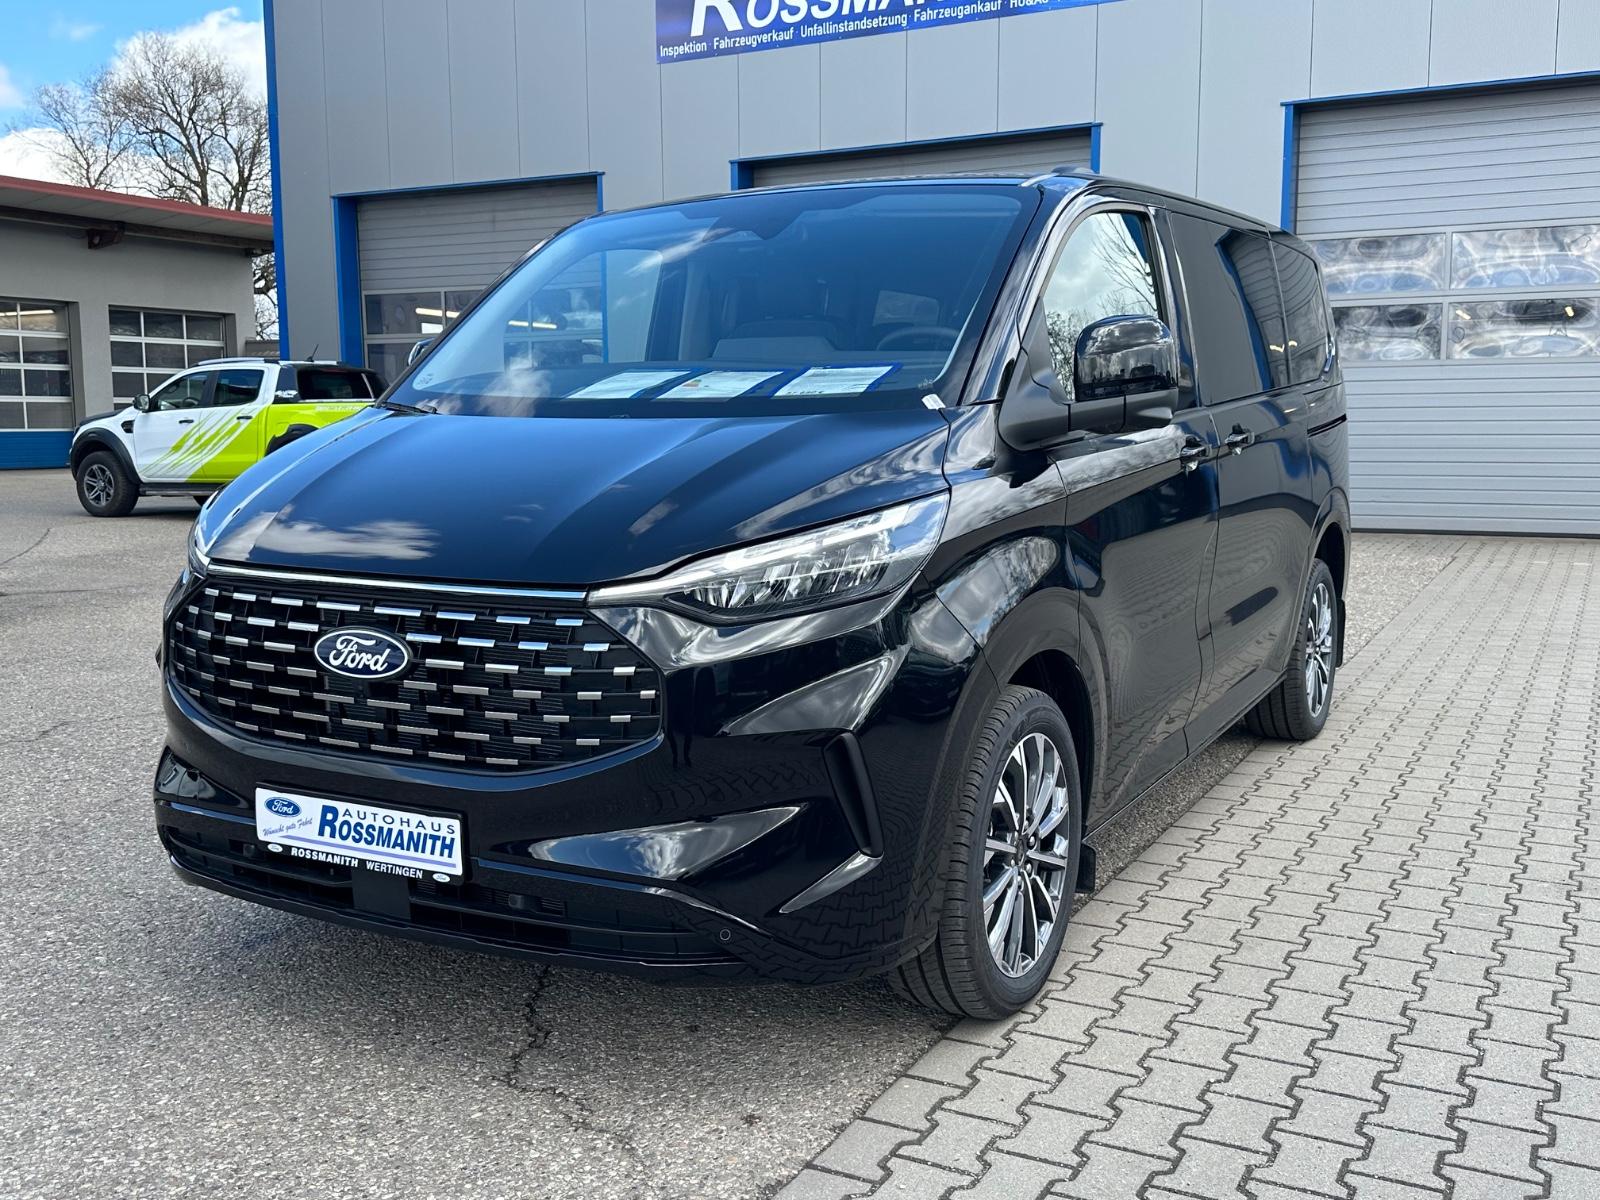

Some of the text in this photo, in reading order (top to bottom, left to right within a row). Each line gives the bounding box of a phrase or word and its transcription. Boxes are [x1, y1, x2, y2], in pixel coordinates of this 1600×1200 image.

[660, 41, 707, 58] Inspektion
[714, 28, 794, 50] Fahrzeugverkauf
[800, 13, 908, 38] Unfallinstandsetzung
[914, 0, 1003, 22] Fahrzeugankauf
[328, 635, 391, 671] Ford
[318, 804, 456, 859] ROSSMANITH
[342, 808, 456, 835] AUTOHAUS
[291, 847, 423, 879] ROSSMANITH WERTINGEN
